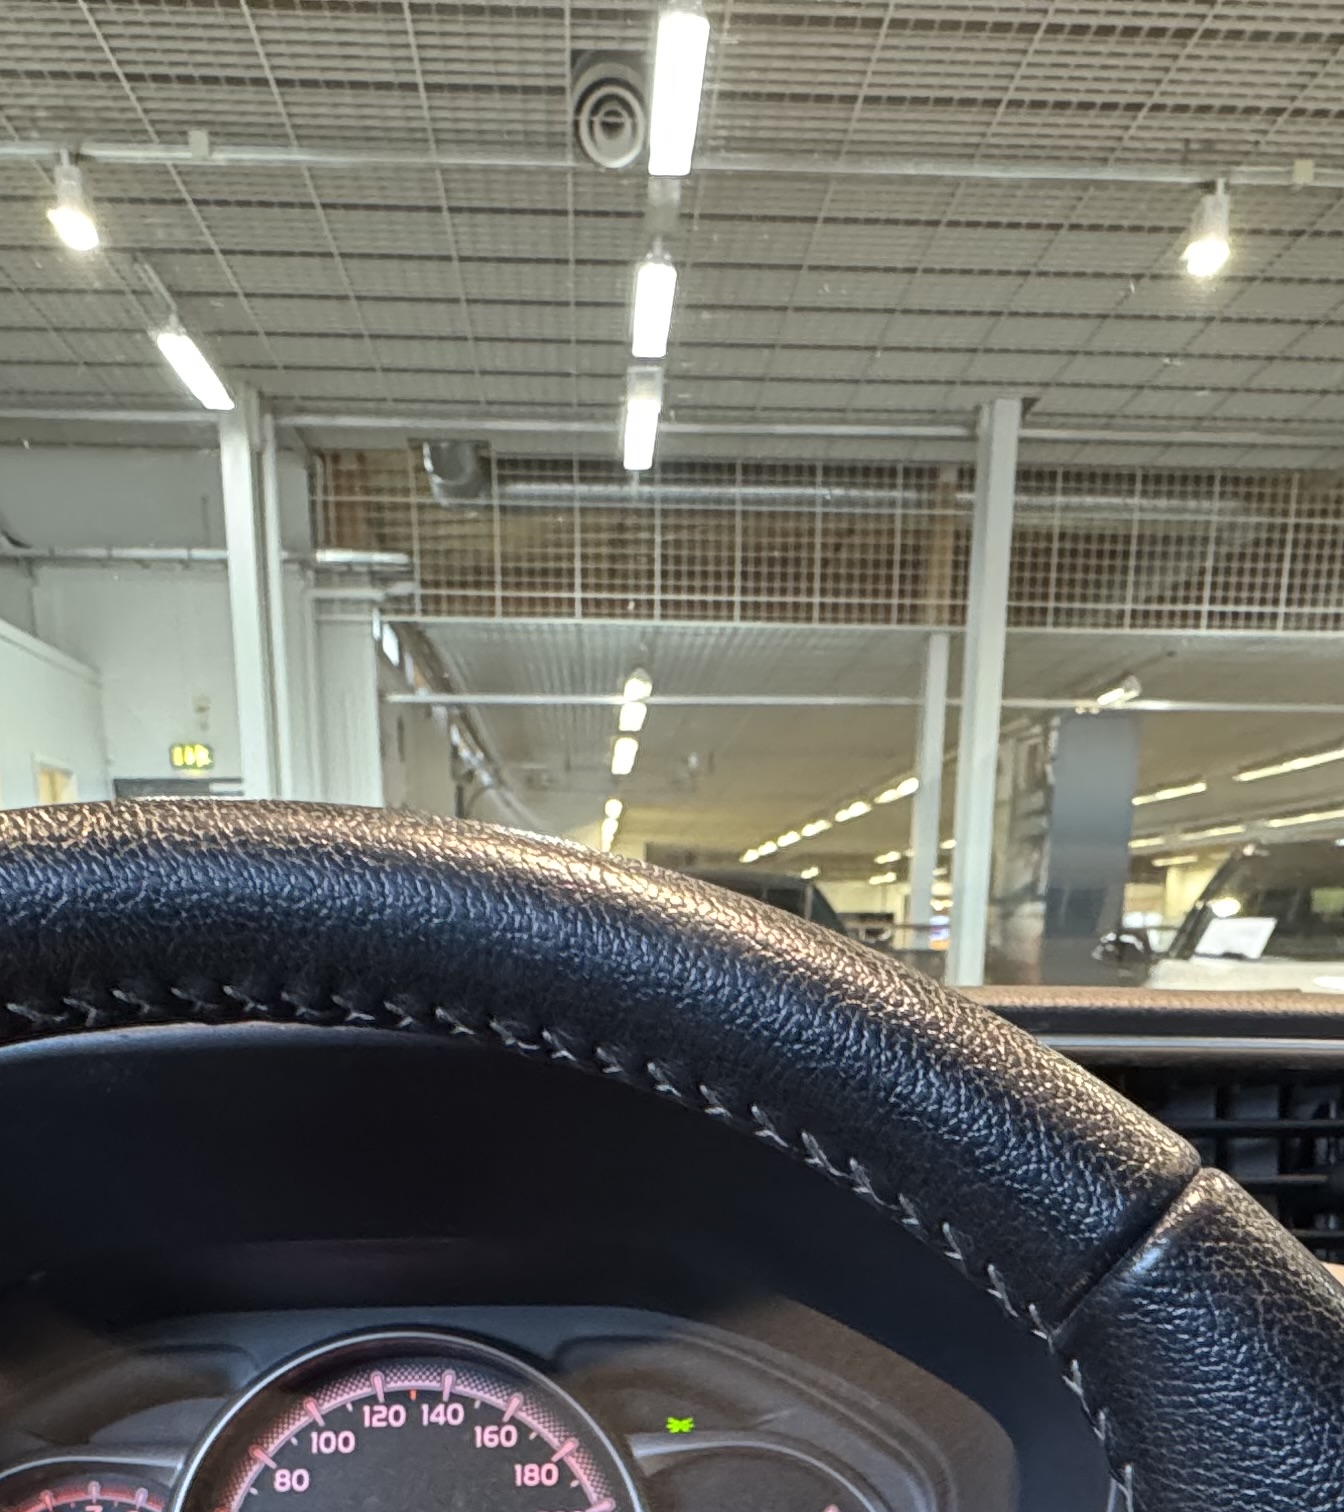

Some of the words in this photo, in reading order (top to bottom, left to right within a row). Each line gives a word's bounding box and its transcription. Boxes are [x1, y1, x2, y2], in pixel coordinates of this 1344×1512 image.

[363, 1404, 406, 1428] 120
[421, 1402, 465, 1427] 140
[310, 1431, 356, 1454] 100
[474, 1425, 518, 1448] 160
[273, 1468, 310, 1492] 80
[514, 1463, 559, 1487] 180
